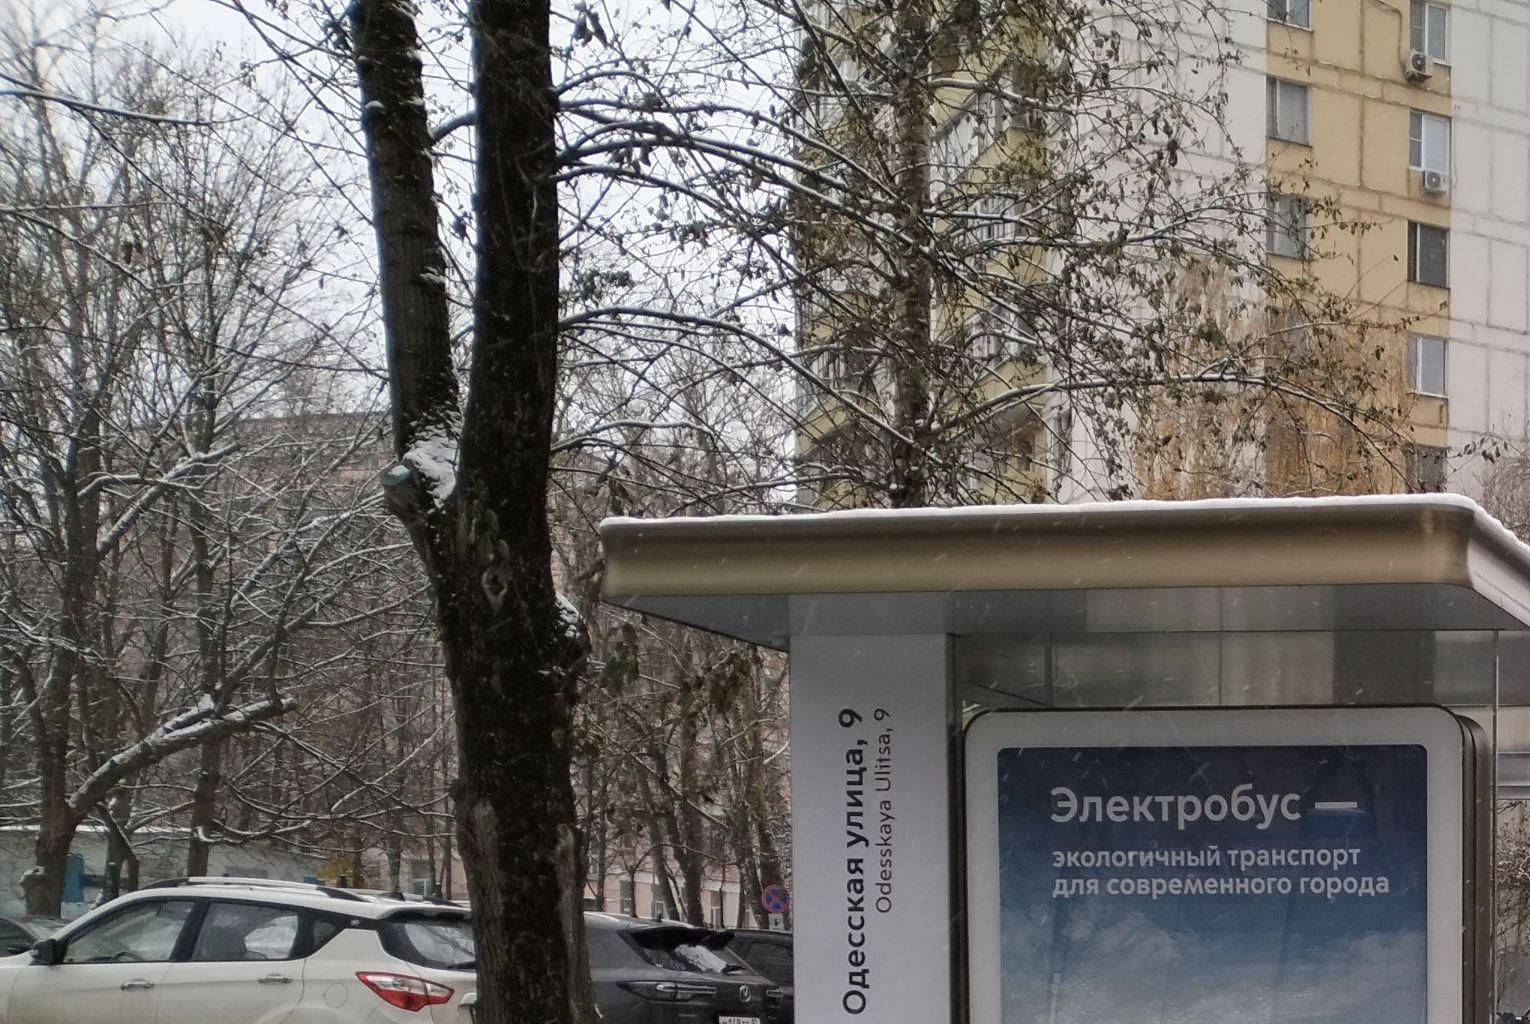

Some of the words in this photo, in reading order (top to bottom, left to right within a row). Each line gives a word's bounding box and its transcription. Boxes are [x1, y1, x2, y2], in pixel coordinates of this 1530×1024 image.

[837, 708, 863, 729] 9
[875, 708, 891, 721] 9
[874, 727, 894, 792] Ulitsa,
[844, 738, 870, 849] улица,
[1049, 784, 1301, 830] Электробус
[874, 800, 896, 914] Odesskaya
[1052, 845, 1222, 870] экологичный
[1226, 845, 1362, 870] транспорт
[1052, 878, 1099, 899] для
[1106, 875, 1292, 899] современного
[1299, 875, 1390, 899] города
[842, 859, 869, 1014] Одесская
